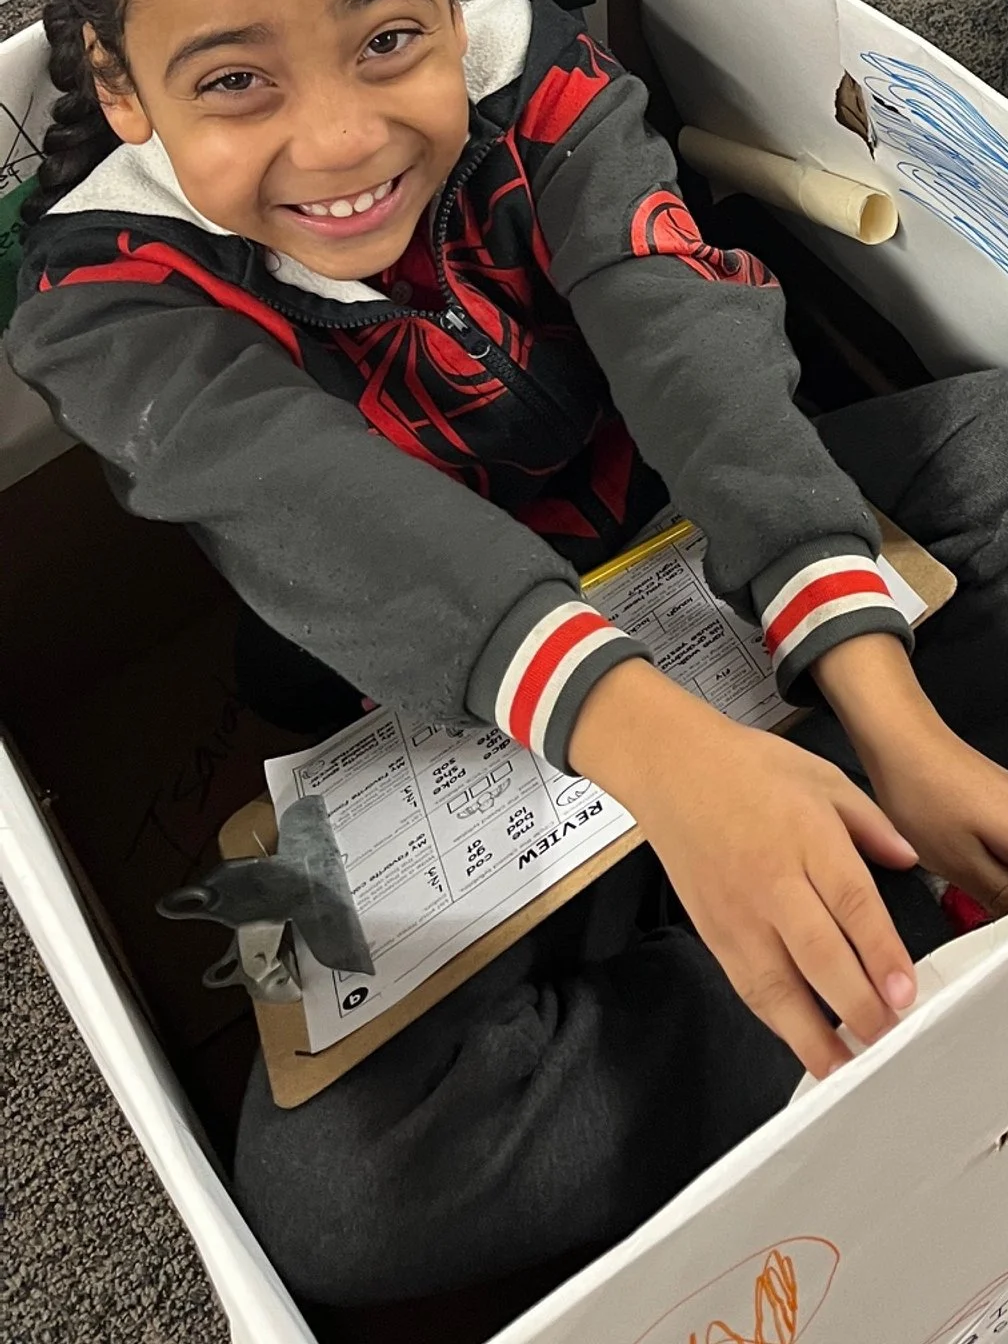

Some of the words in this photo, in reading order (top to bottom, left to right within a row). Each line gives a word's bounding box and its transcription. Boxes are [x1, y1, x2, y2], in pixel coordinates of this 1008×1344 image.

[431, 757, 457, 777] sob
[434, 766, 458, 784] she
[431, 768, 467, 796] poke
[505, 811, 534, 834] bad
[507, 806, 527, 823] lot
[510, 821, 534, 841] me
[514, 800, 603, 869] REVIEW
[466, 839, 482, 853] at
[467, 845, 485, 862] go
[464, 852, 493, 875] cod
